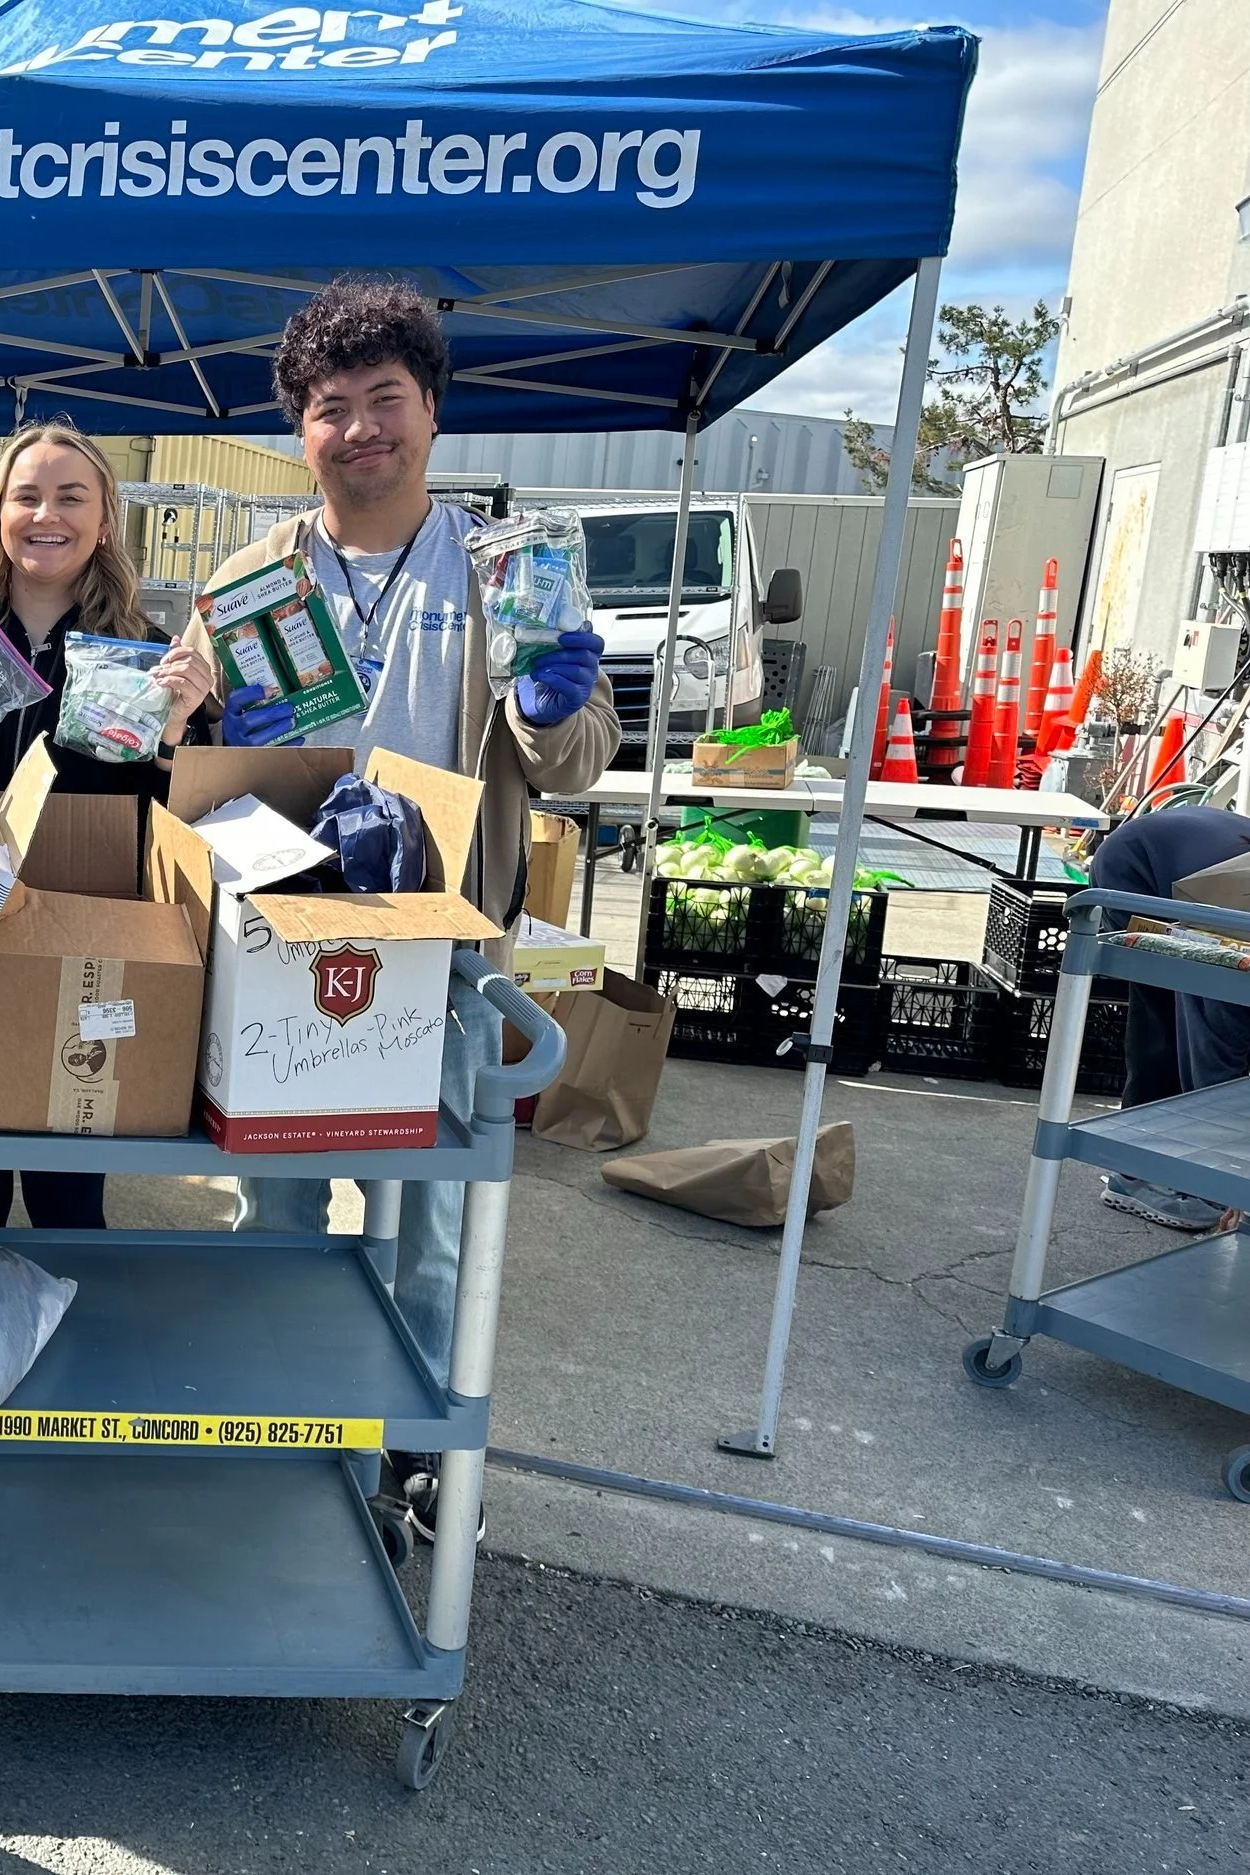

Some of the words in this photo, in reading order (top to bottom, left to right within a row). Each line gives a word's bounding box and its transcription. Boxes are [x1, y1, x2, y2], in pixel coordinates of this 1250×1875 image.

[257, 590, 271, 600] SHEA
[272, 580, 293, 593] BUTTER
[260, 579, 282, 592] ALMOND
[216, 593, 249, 617] Suave
[284, 618, 308, 635] Suave
[235, 640, 258, 657] Suave
[301, 706, 317, 717] SHEA
[318, 696, 340, 710] BUTTER
[302, 690, 338, 708] NATURAL
[108, 728, 140, 750] Colgate
[83, 957, 97, 988] ESP
[572, 976, 594, 984] Flakes
[324, 967, 366, 1002] K-J
[272, 1038, 367, 1083] Umbrellas
[378, 1017, 443, 1060] Moscato
[368, 1128, 423, 1136] STEWARDSHIP
[37, 1416, 97, 1438] MARKET
[101, 1418, 127, 1443] ST.,
[132, 1418, 199, 1441] CONCORD
[218, 1421, 262, 1445] (925)
[268, 1423, 343, 1445] 825-7751
